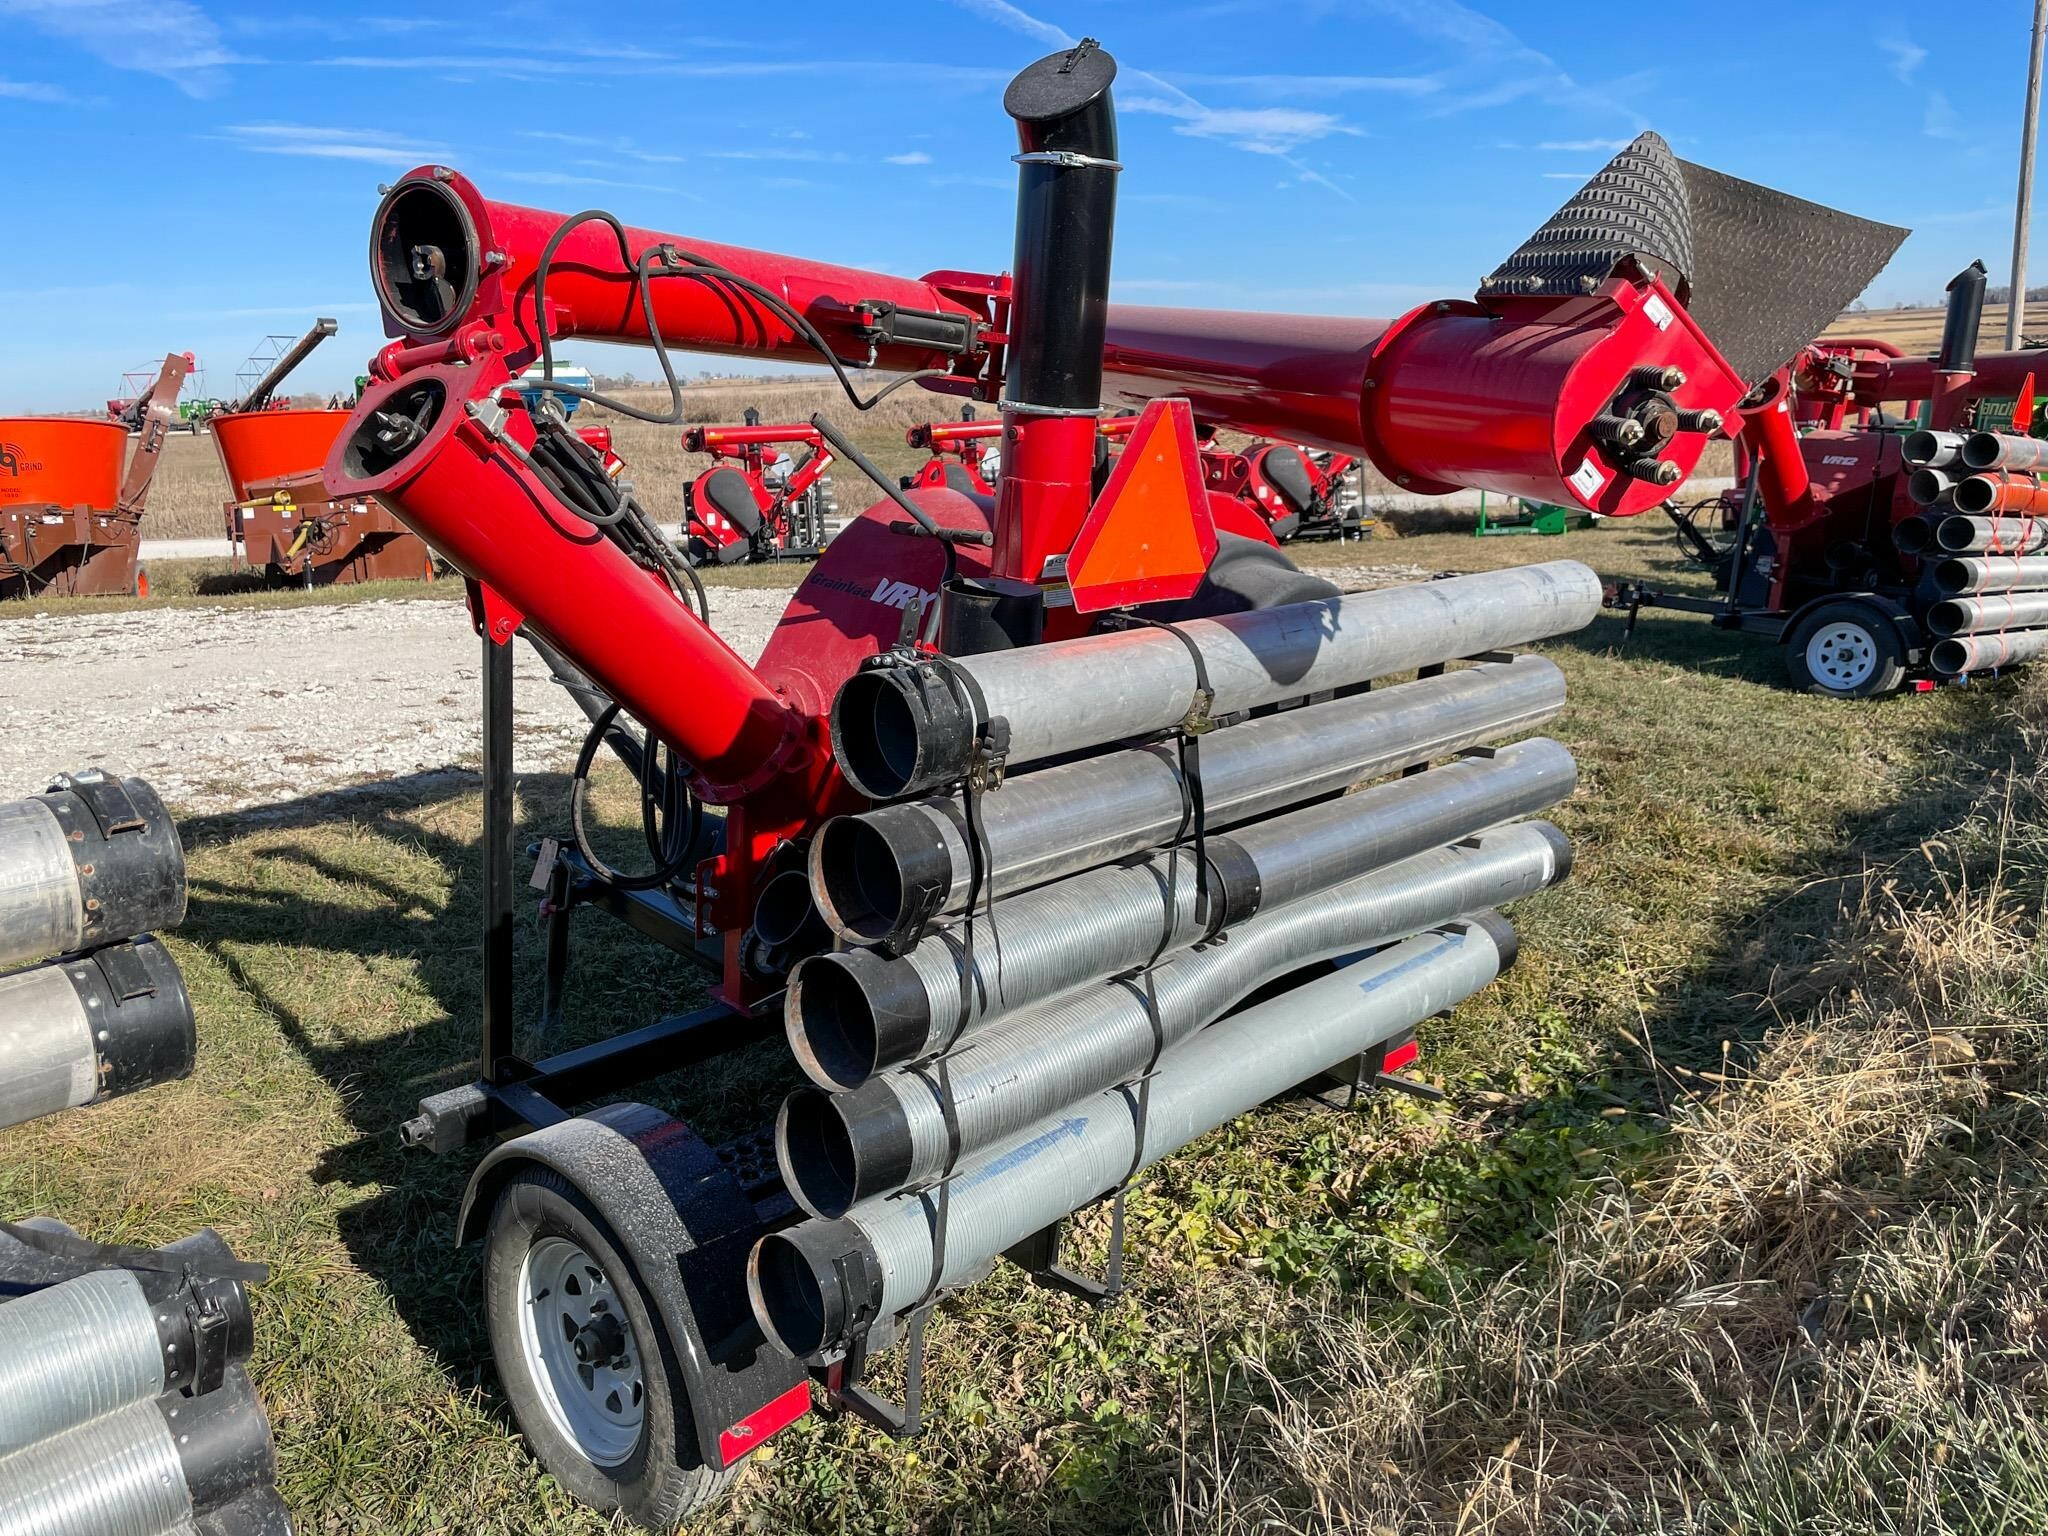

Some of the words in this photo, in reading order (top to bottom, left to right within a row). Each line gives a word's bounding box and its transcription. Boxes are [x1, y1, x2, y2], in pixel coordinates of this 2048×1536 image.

[1822, 455, 1858, 465] VR12
[20, 462, 43, 471] GRIND
[810, 573, 871, 598] GrainVac
